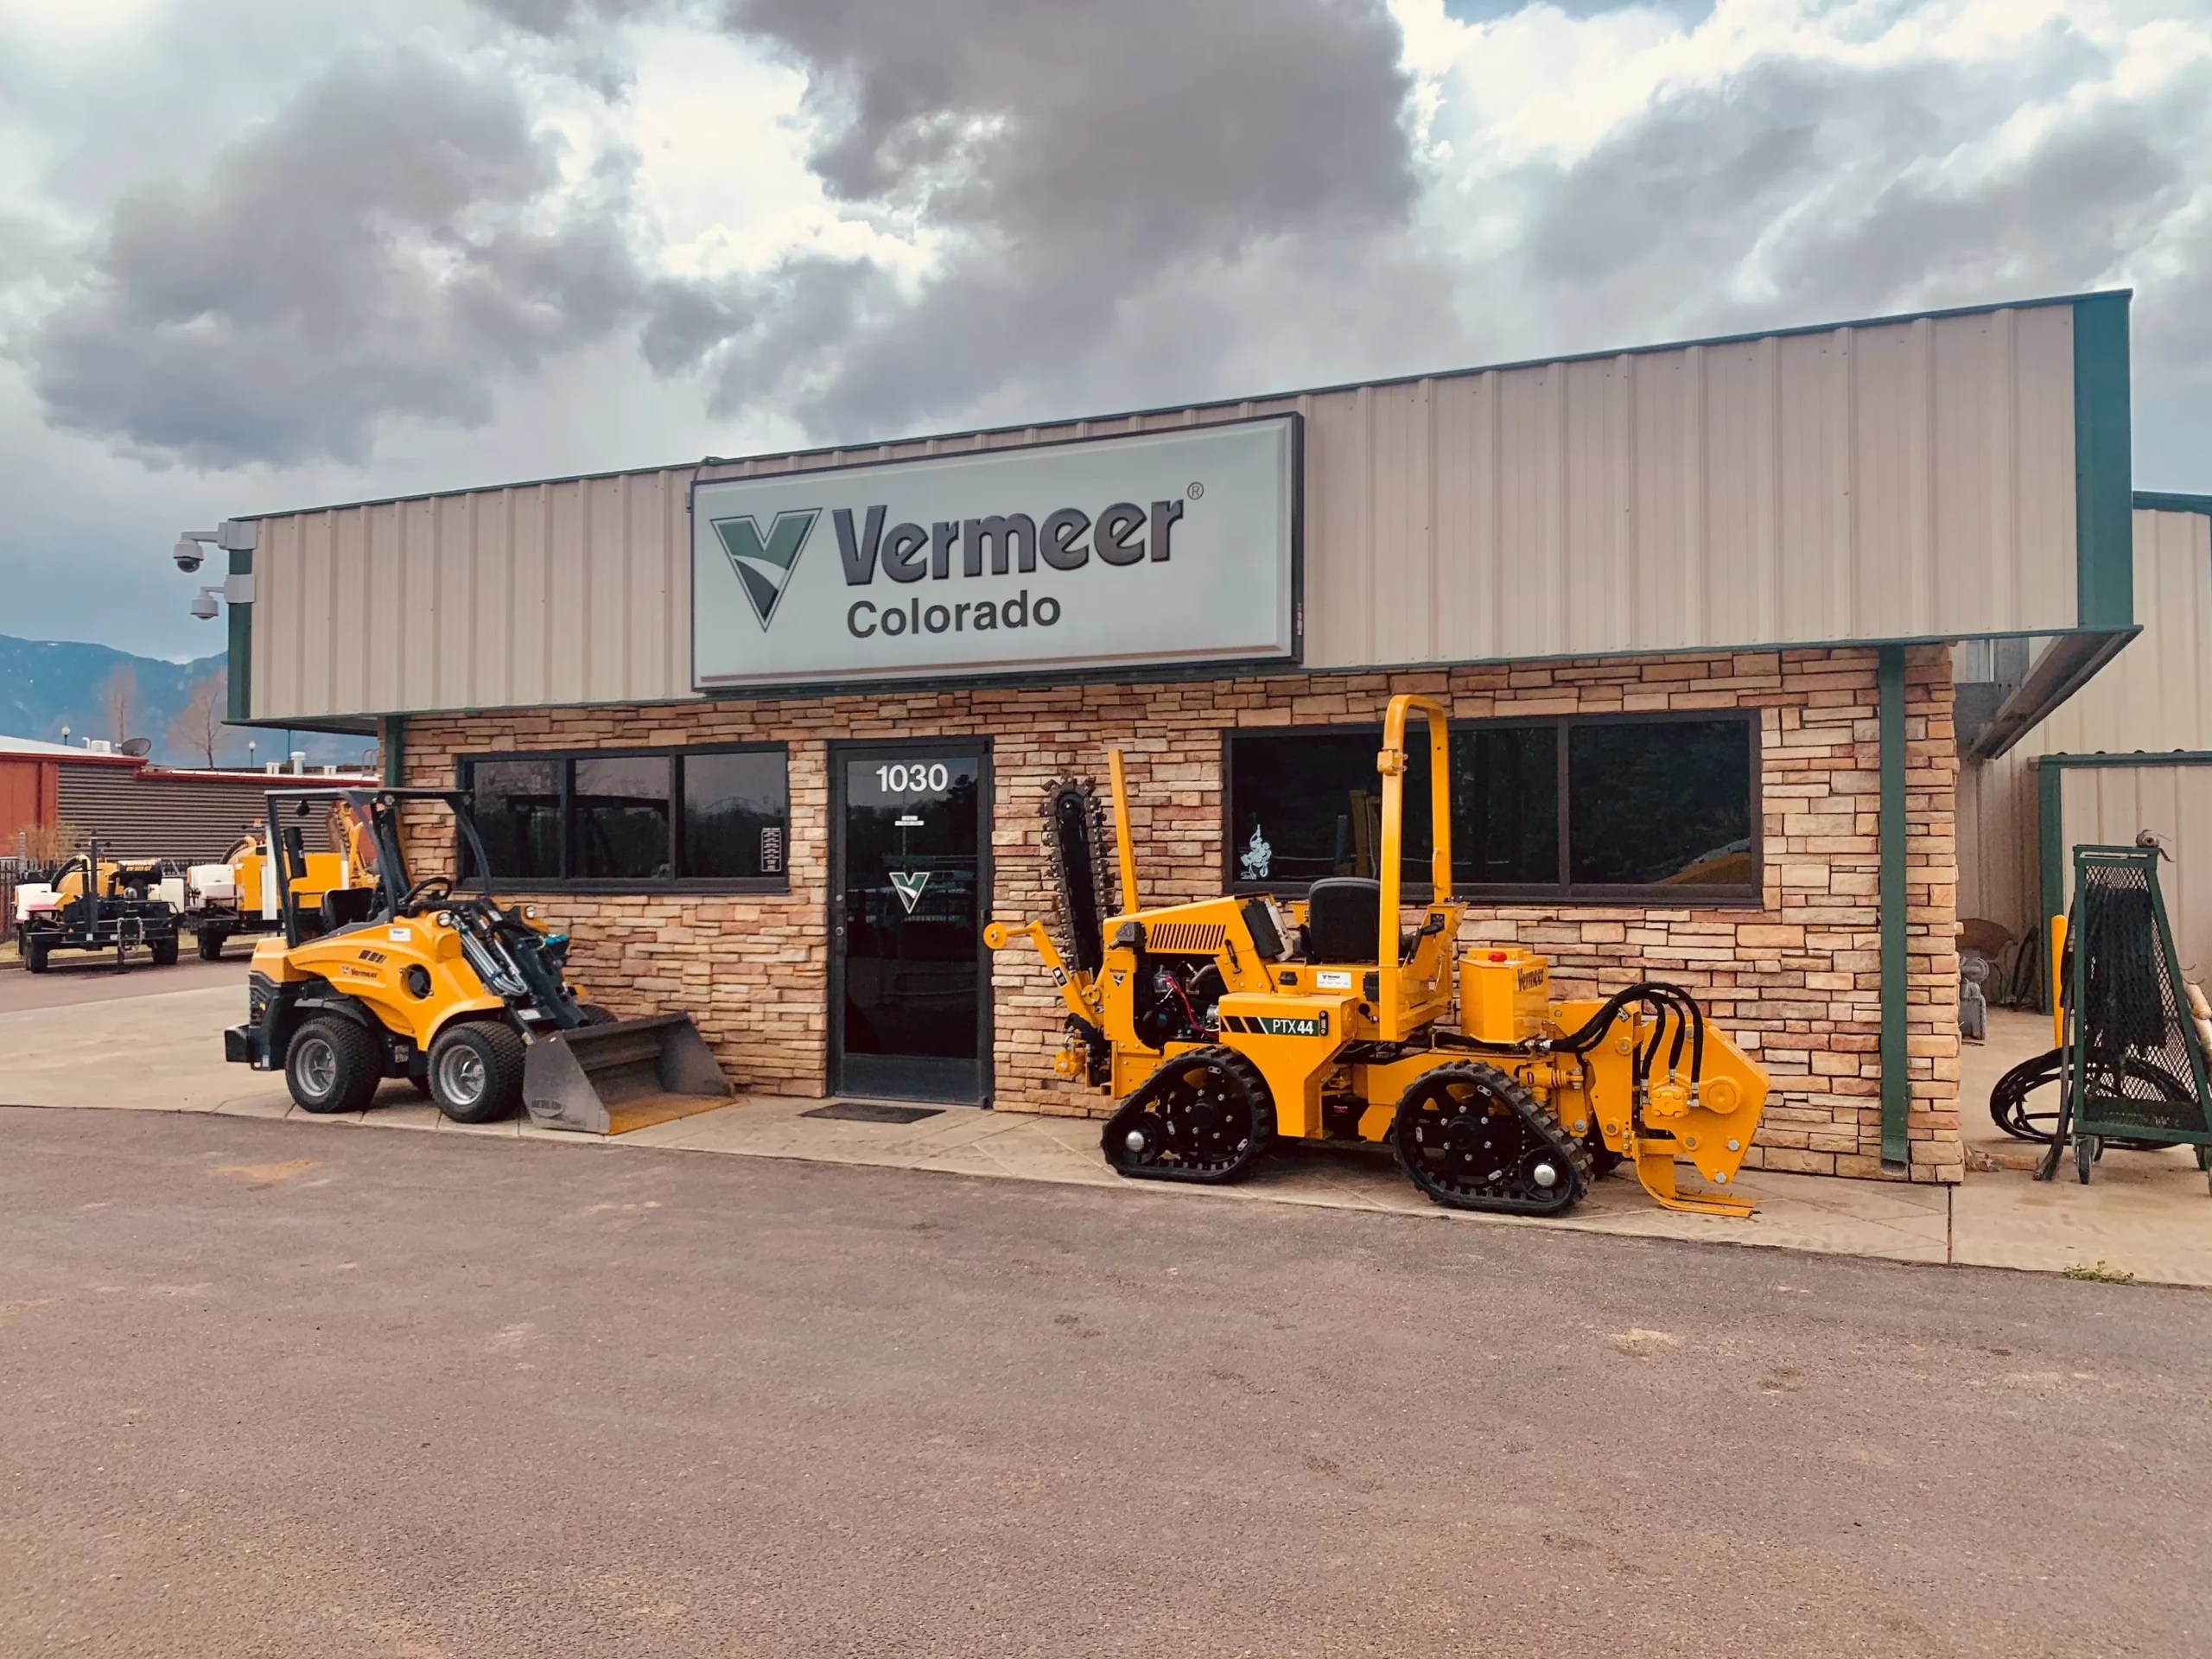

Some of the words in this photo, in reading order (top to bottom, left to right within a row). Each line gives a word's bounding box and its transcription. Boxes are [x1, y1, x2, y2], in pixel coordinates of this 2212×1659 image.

[832, 499, 1184, 586] Vermeer
[847, 590, 1061, 638] Colorado
[875, 763, 949, 792] 1030
[1517, 968, 1544, 992] Vermeer
[1273, 1019, 1314, 1035] PTX44
